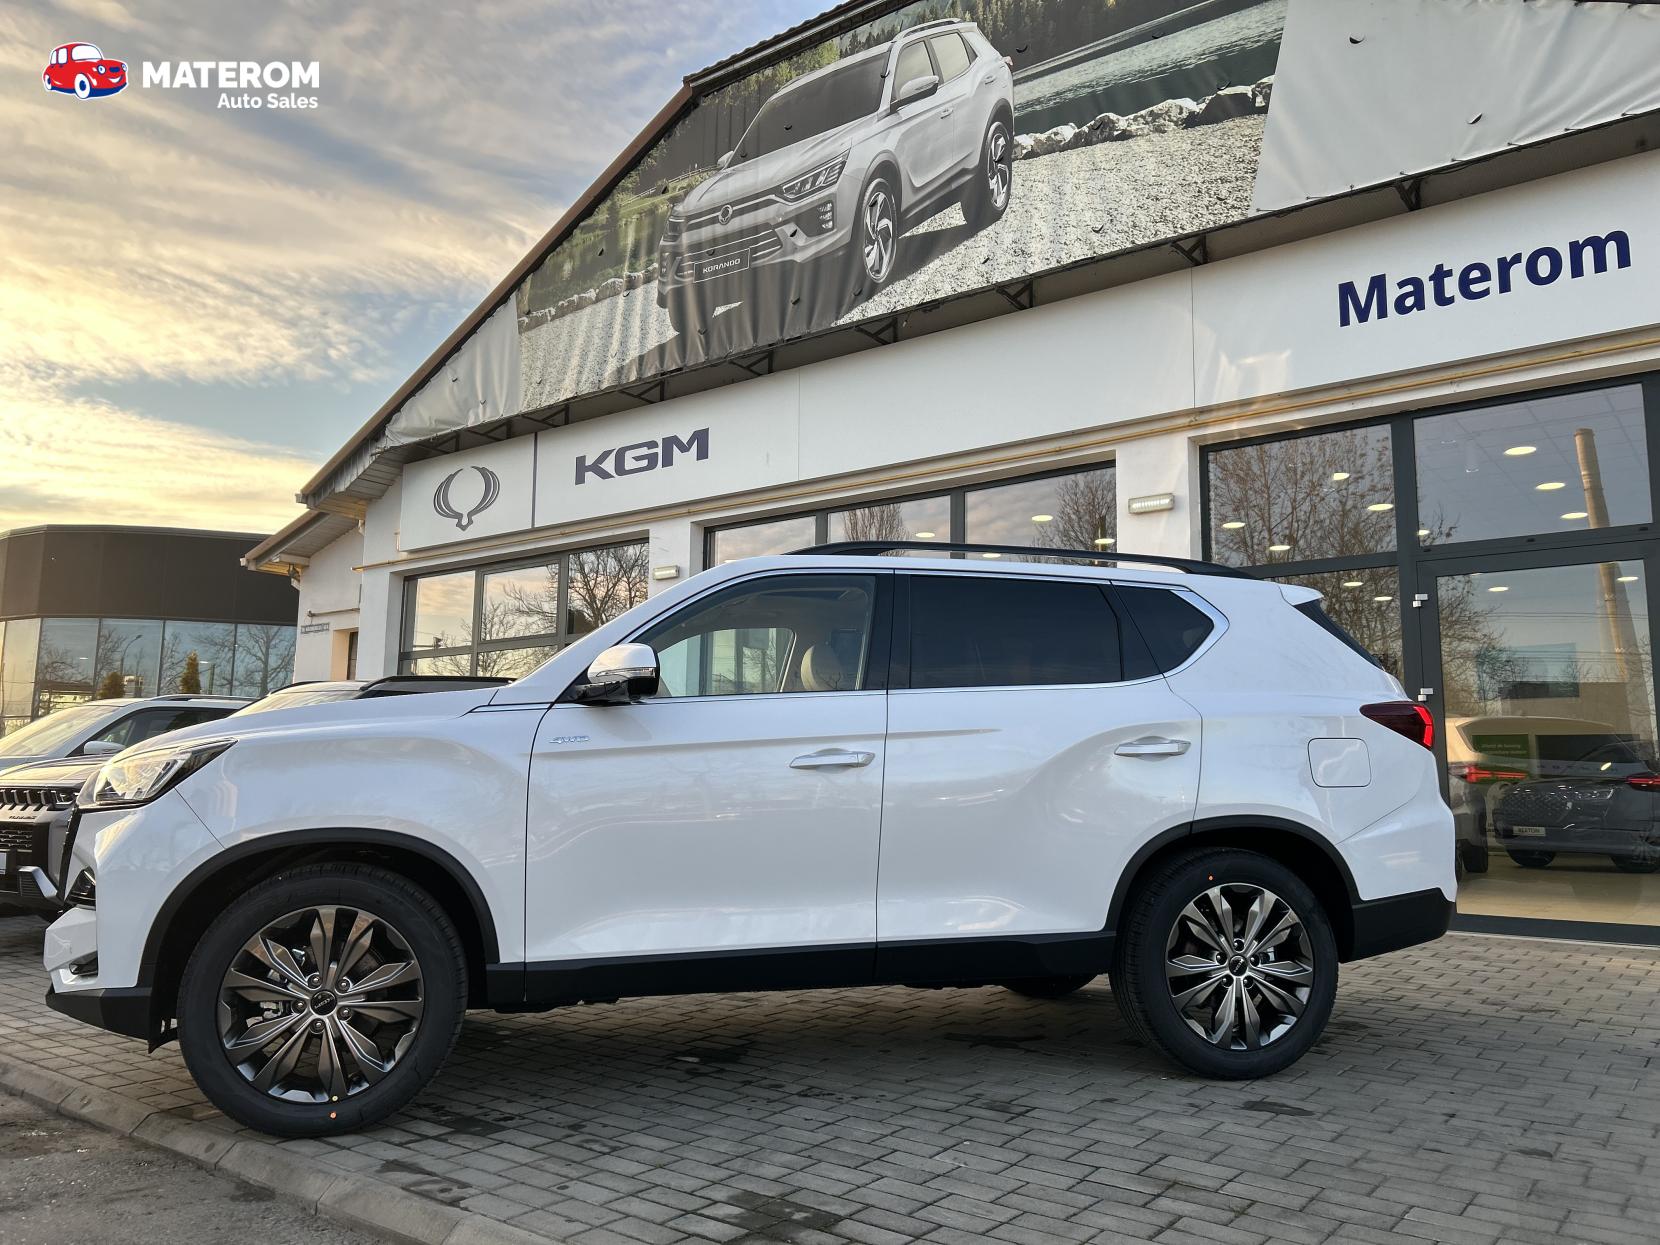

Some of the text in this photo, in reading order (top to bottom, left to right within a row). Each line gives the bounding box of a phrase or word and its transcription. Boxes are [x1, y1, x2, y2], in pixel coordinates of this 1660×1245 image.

[703, 258, 741, 273] KORANDO
[1338, 229, 1632, 327] Materom
[575, 427, 709, 486] KGM
